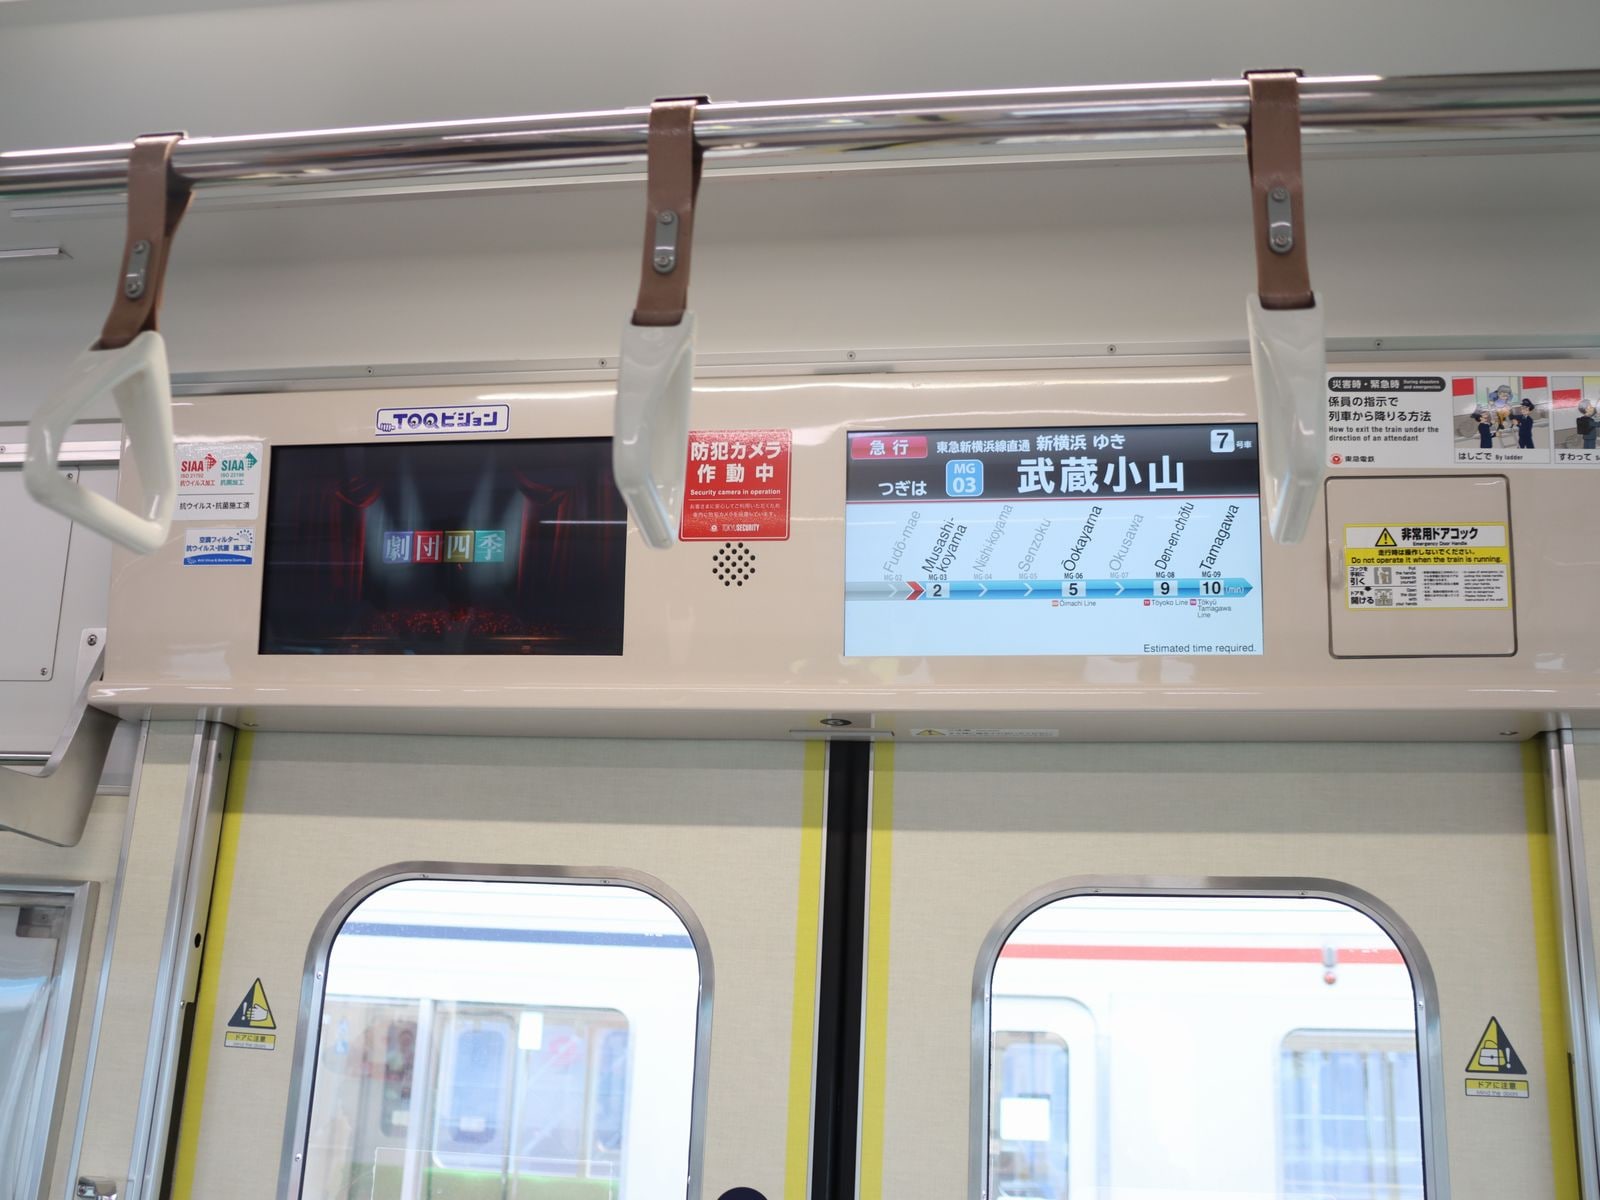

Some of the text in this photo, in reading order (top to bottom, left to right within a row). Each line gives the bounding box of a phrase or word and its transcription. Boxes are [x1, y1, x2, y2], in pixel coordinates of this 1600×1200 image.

[1332, 380, 1400, 389] 災害時・緊急時
[1328, 396, 1398, 407] 係員の指示で
[1328, 410, 1432, 422] 列車から降りる方法
[870, 439, 909, 456] 急行
[936, 434, 1126, 454] 東急新横浜線直通 新横浜 ゆき
[1216, 432, 1252, 449] 7 号車
[690, 441, 782, 461] 防犯カメラ
[1458, 452, 1492, 460] はしごで
[1558, 453, 1592, 461] すわって
[181, 460, 204, 472] SIAA
[221, 459, 244, 471] SIAA
[953, 463, 976, 474] MG
[1017, 455, 1185, 494] 武蔵小山
[750, 488, 781, 496] operation
[878, 481, 928, 497] つぎは
[952, 477, 977, 494] 03
[180, 502, 250, 510] 抗ウイルス・抗菌施工済
[972, 503, 1014, 572] Nishi-koyama
[1199, 504, 1240, 570] Tamagawa
[1401, 527, 1479, 541] 非常用ドアコック
[385, 534, 503, 561] 劇団四季
[921, 516, 954, 573] Musashi-
[936, 524, 968, 573] koyama
[1018, 518, 1051, 572] Senzoku
[1109, 514, 1144, 571] Okusawa
[1377, 557, 1404, 565] operate
[1473, 556, 1503, 564] running.
[1202, 581, 1221, 595] 10
[1350, 577, 1365, 585] 引く
[933, 584, 943, 597] 2
[1069, 583, 1078, 596] 5
[1160, 582, 1170, 596] 9
[1144, 644, 1256, 654] Estimated time required.
[1478, 1081, 1516, 1090] ドアに注意
